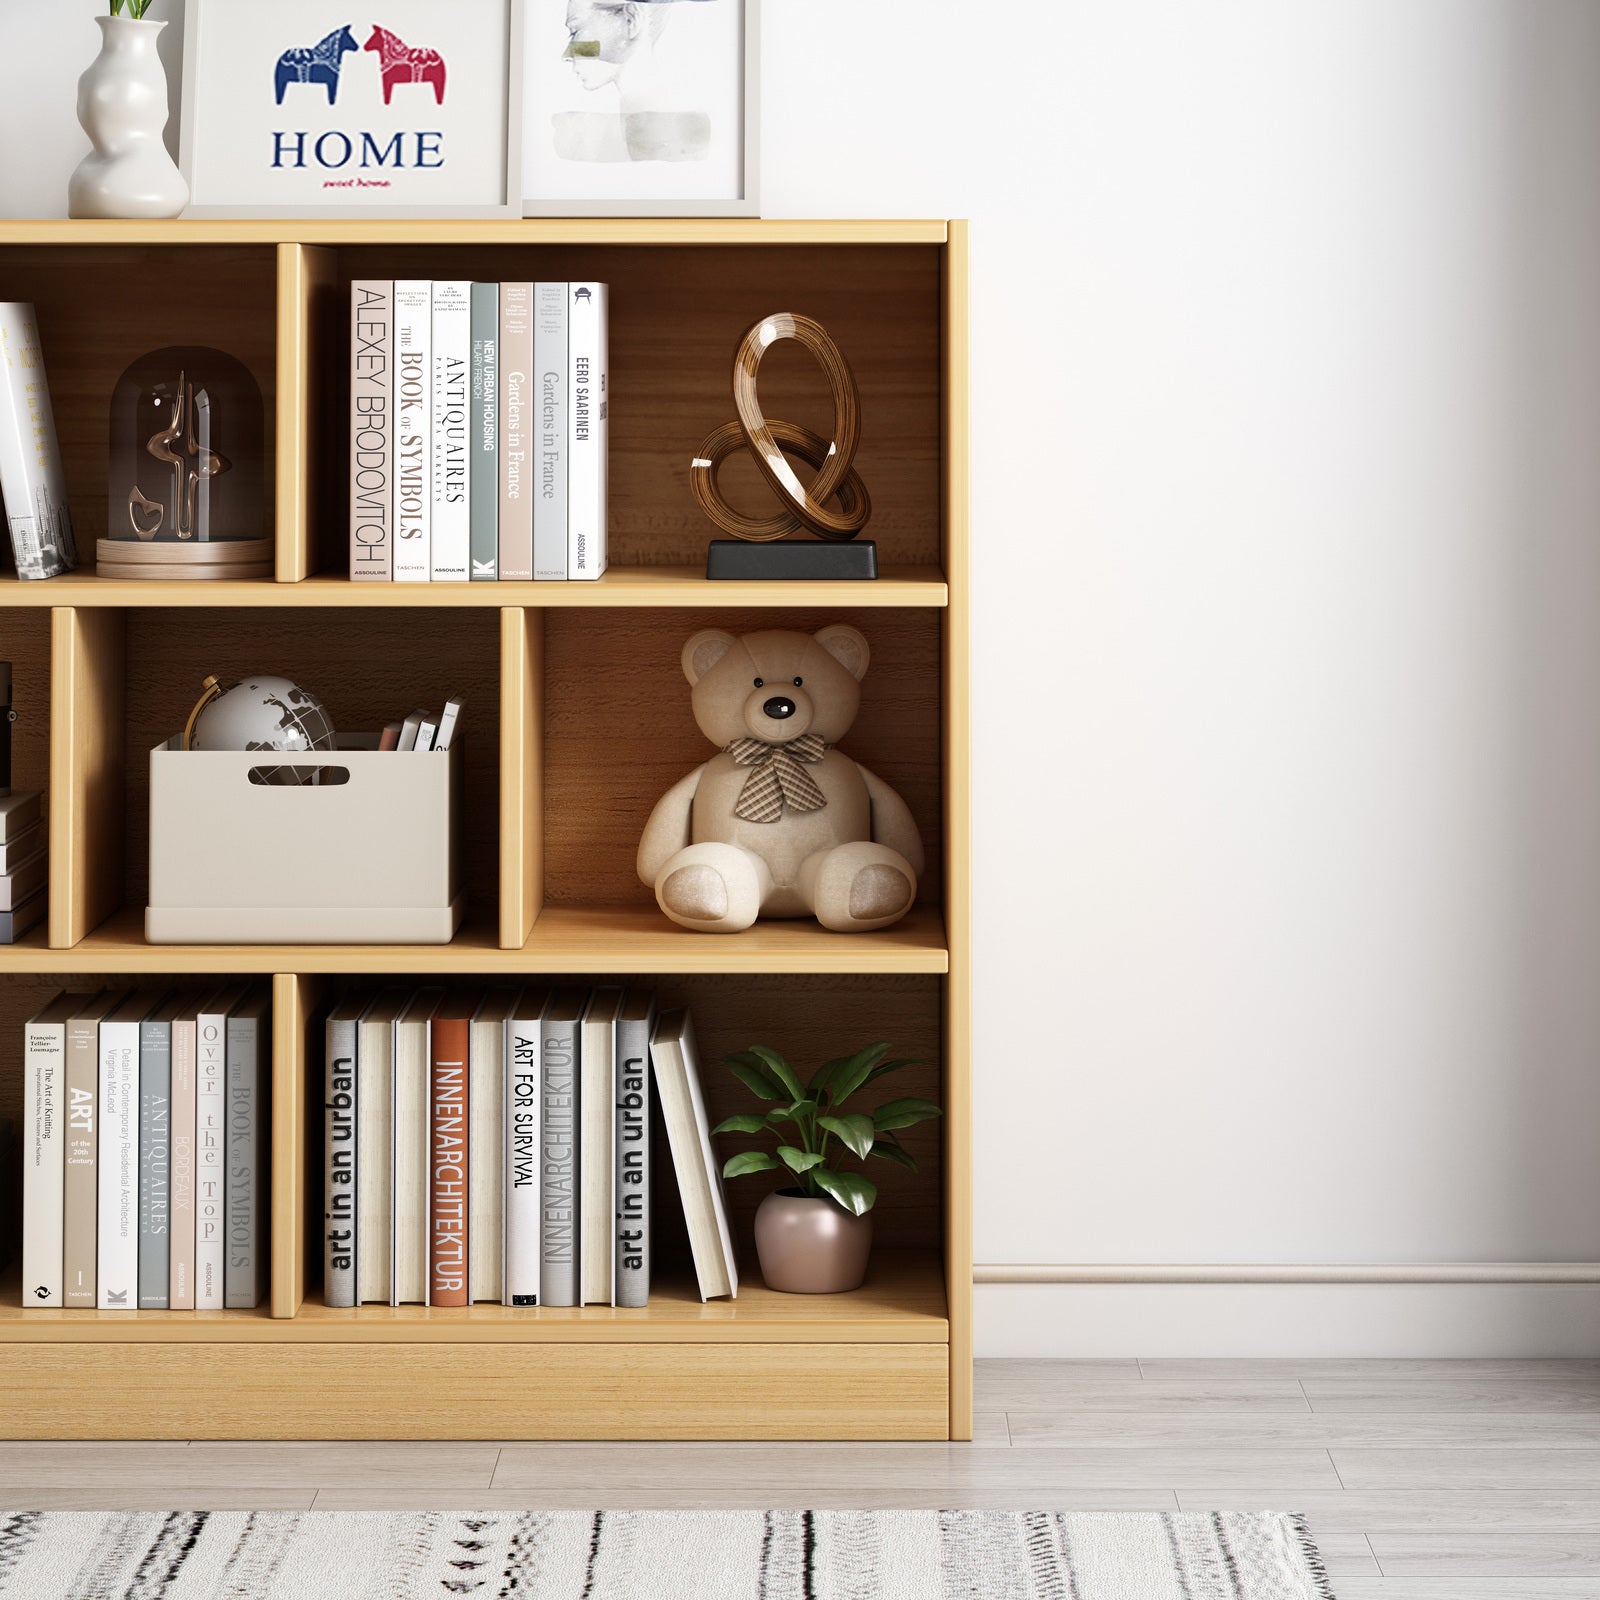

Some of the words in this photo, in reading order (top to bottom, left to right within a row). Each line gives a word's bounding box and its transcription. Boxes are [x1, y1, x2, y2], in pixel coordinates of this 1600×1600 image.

[271, 131, 446, 168] HOME
[356, 288, 386, 387] ALEXEY
[400, 326, 411, 346] THE
[474, 340, 482, 367] HILARY
[483, 340, 495, 363] NEW
[400, 352, 423, 410] BOOK
[473, 368, 482, 399] FRENCH
[483, 366, 495, 402] URBAN
[576, 357, 589, 384] EERO
[507, 371, 525, 430] Gardens
[542, 371, 560, 430] Gardens
[576, 387, 589, 441] SAARINEN
[400, 416, 411, 430] OF
[442, 357, 465, 503] ANTIQUAIRES
[483, 404, 495, 451] HOUSING
[507, 433, 525, 447] in
[542, 433, 559, 447] in
[356, 396, 386, 562] BRODOVITCH
[399, 435, 423, 540] SYMBOLS
[507, 450, 525, 499] France
[542, 450, 559, 499] France
[577, 533, 586, 570] ASSOULINE
[106, 1049, 117, 1079] Virginia
[121, 1048, 131, 1071] Detail
[203, 1025, 218, 1093] Over
[231, 1062, 240, 1081] THE
[514, 1036, 534, 1067] ART
[45, 1067, 53, 1082] The
[121, 1073, 131, 1081] in
[514, 1074, 534, 1108] FOR
[45, 1098, 53, 1107] of
[70, 1087, 93, 1133] ART
[107, 1081, 117, 1114] McLeod
[119, 1083, 131, 1140] Contemporary
[231, 1087, 251, 1144] BOOK
[326, 1056, 352, 1141] urban
[616, 1056, 643, 1141] urban
[41, 1108, 52, 1139] Knitting
[204, 1113, 216, 1163] the
[121, 1142, 131, 1186] Residential
[149, 1095, 167, 1235] ANTIQUAIRES
[332, 1151, 352, 1184] an
[514, 1113, 534, 1188] SURVIVAL
[544, 1037, 573, 1264] INNENARCHITEKTUR
[624, 1151, 643, 1184] an
[174, 1136, 190, 1211] BORDEAUX
[435, 1061, 463, 1292] INNENARCHITEKTUR
[120, 1188, 130, 1237] Architecture
[202, 1181, 217, 1239] Top
[230, 1166, 250, 1268] SYMBOLS
[325, 1193, 352, 1219] in
[616, 1193, 643, 1219] in
[327, 1229, 352, 1270] art
[620, 1229, 643, 1270] art
